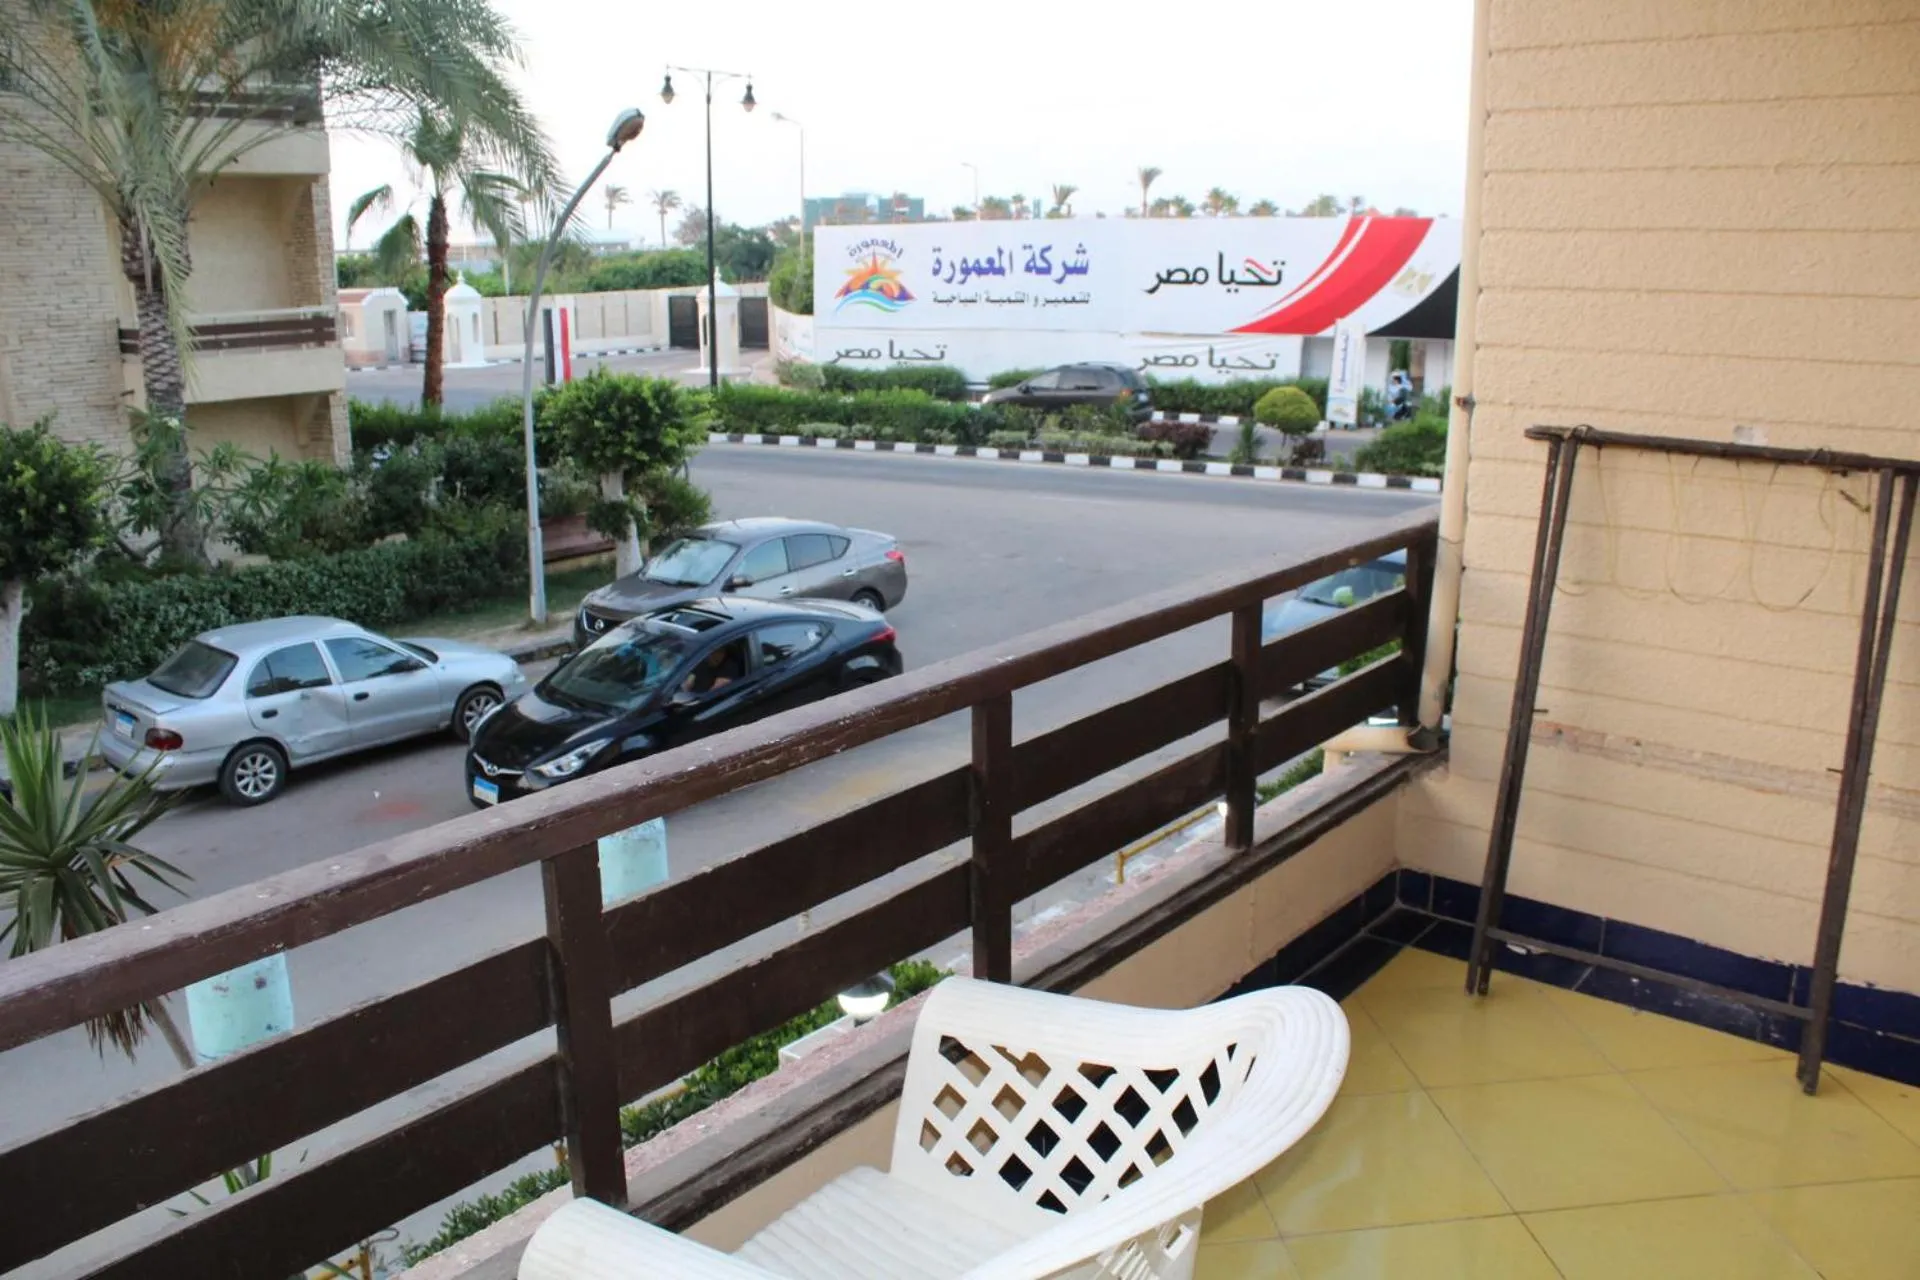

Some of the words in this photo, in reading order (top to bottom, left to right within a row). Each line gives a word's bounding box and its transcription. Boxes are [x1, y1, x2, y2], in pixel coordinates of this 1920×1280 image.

[931, 245, 1014, 285] المعمورة
[1022, 243, 1090, 284] شركة
[1217, 251, 1286, 294] تحيا
[1141, 266, 1210, 294] مصر
[824, 347, 882, 365] مصر
[888, 338, 949, 366] تحيا
[1136, 354, 1199, 372] مصر
[1207, 345, 1280, 374] تحيا
